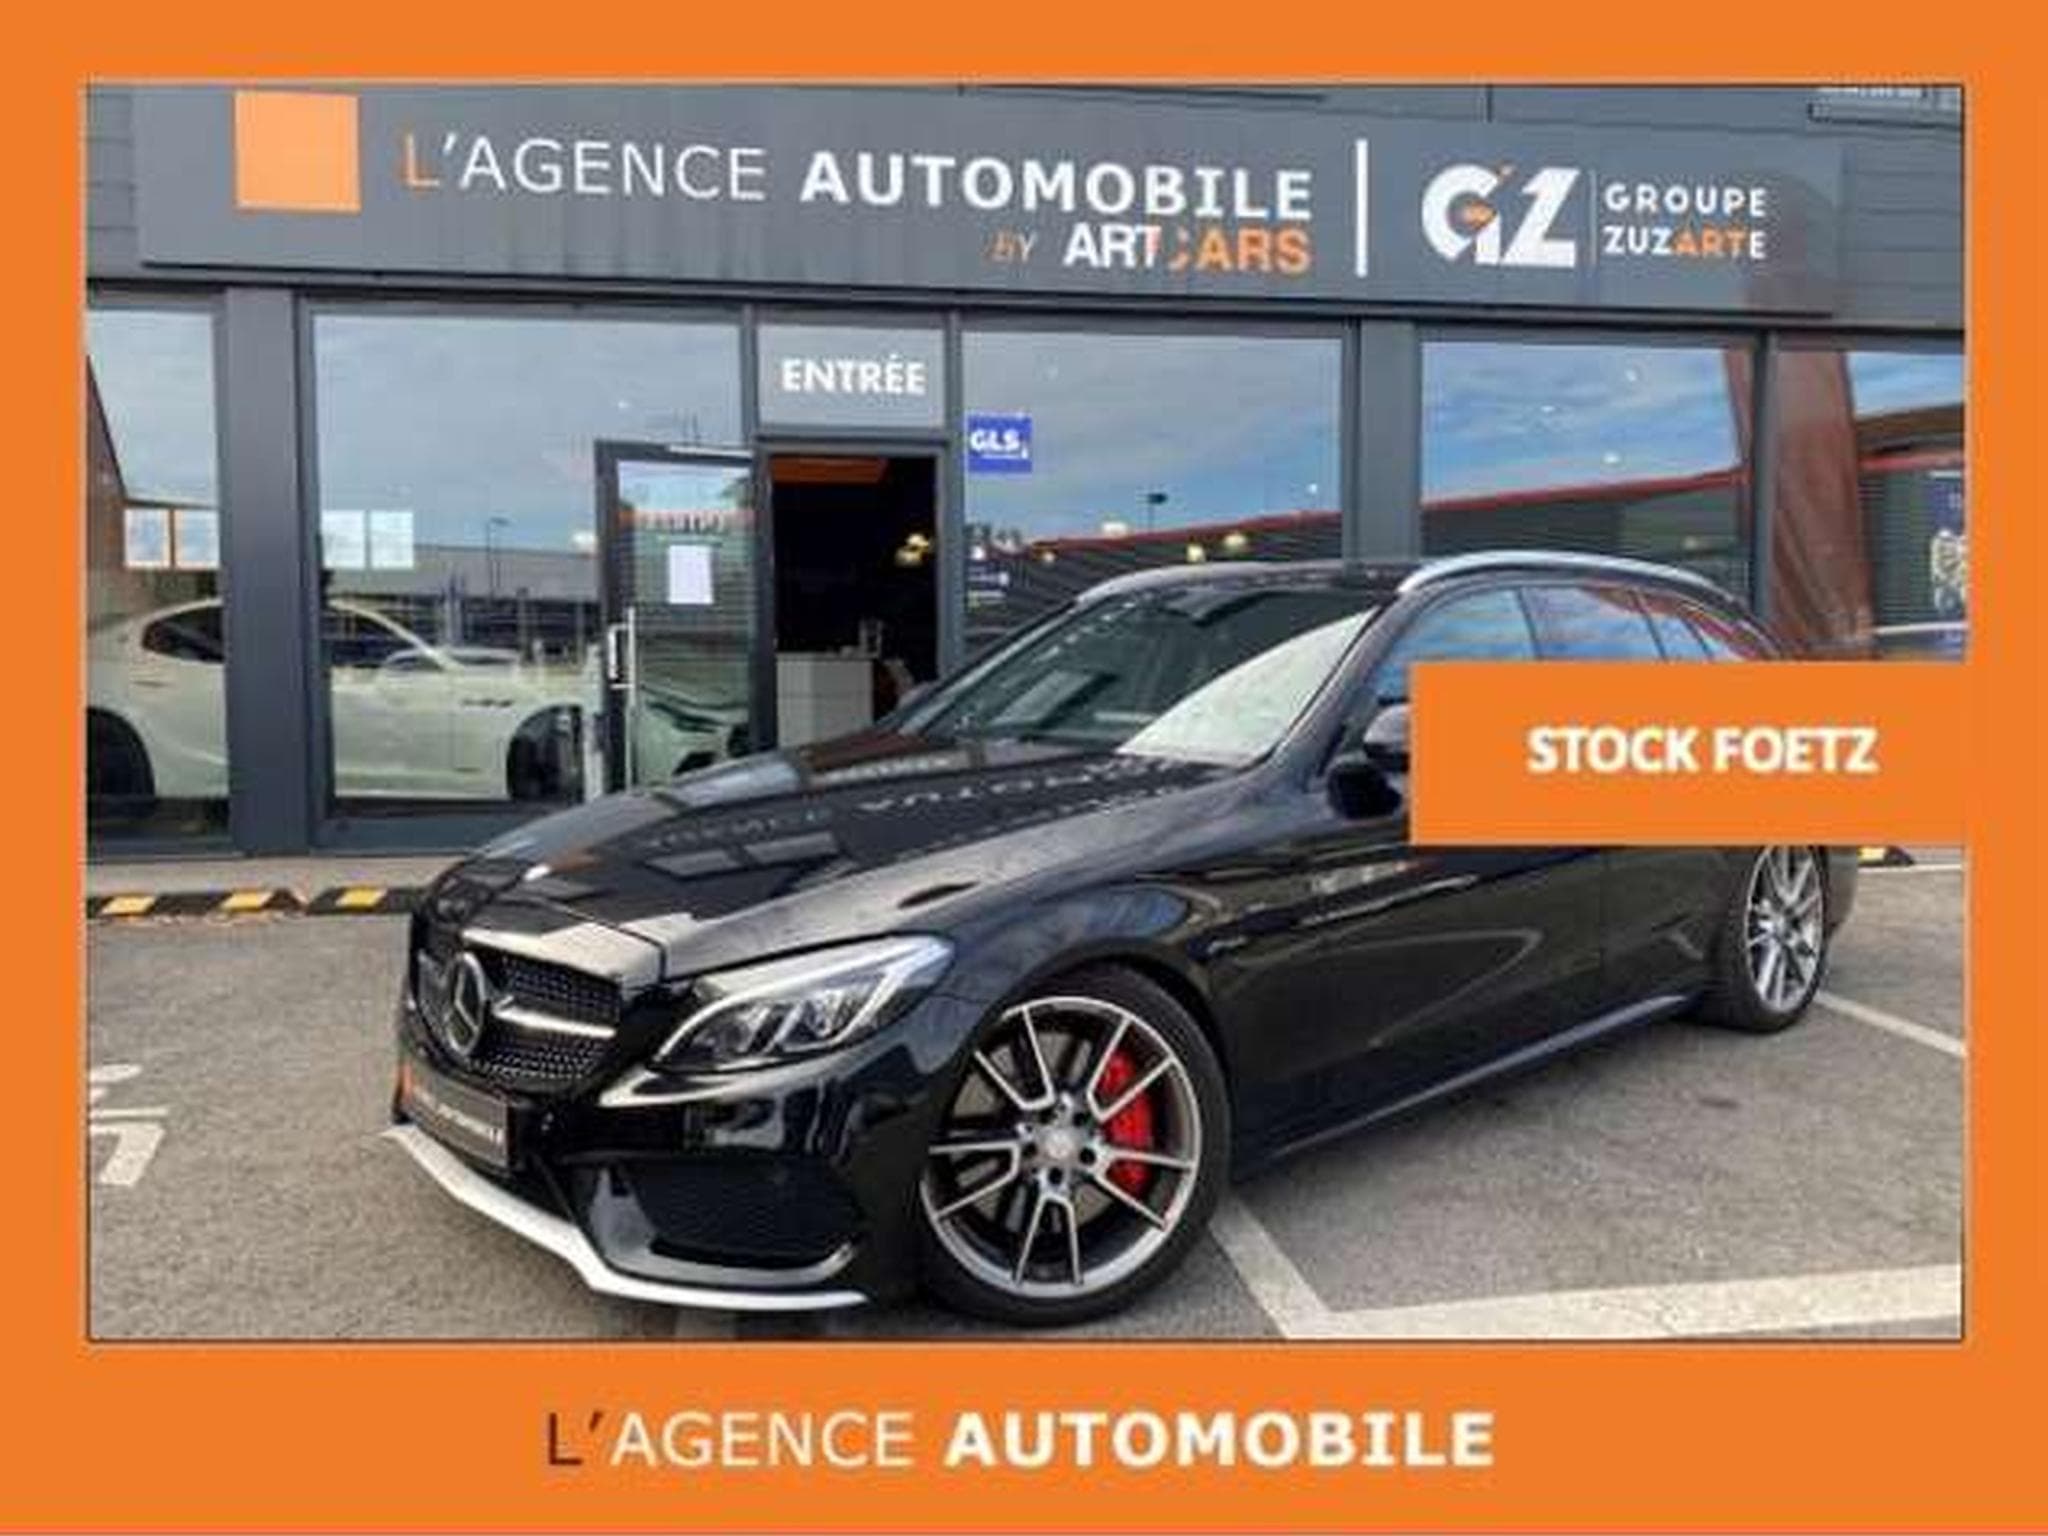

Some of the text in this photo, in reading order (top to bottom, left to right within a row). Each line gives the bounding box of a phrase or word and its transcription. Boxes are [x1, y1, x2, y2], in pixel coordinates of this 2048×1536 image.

[402, 132, 1313, 220] L'AGENCE AUTOMOBILE
[1604, 183, 1767, 218] GROUPE
[1603, 225, 1767, 260] ZUZARTE
[780, 354, 927, 396] ENTRÉE
